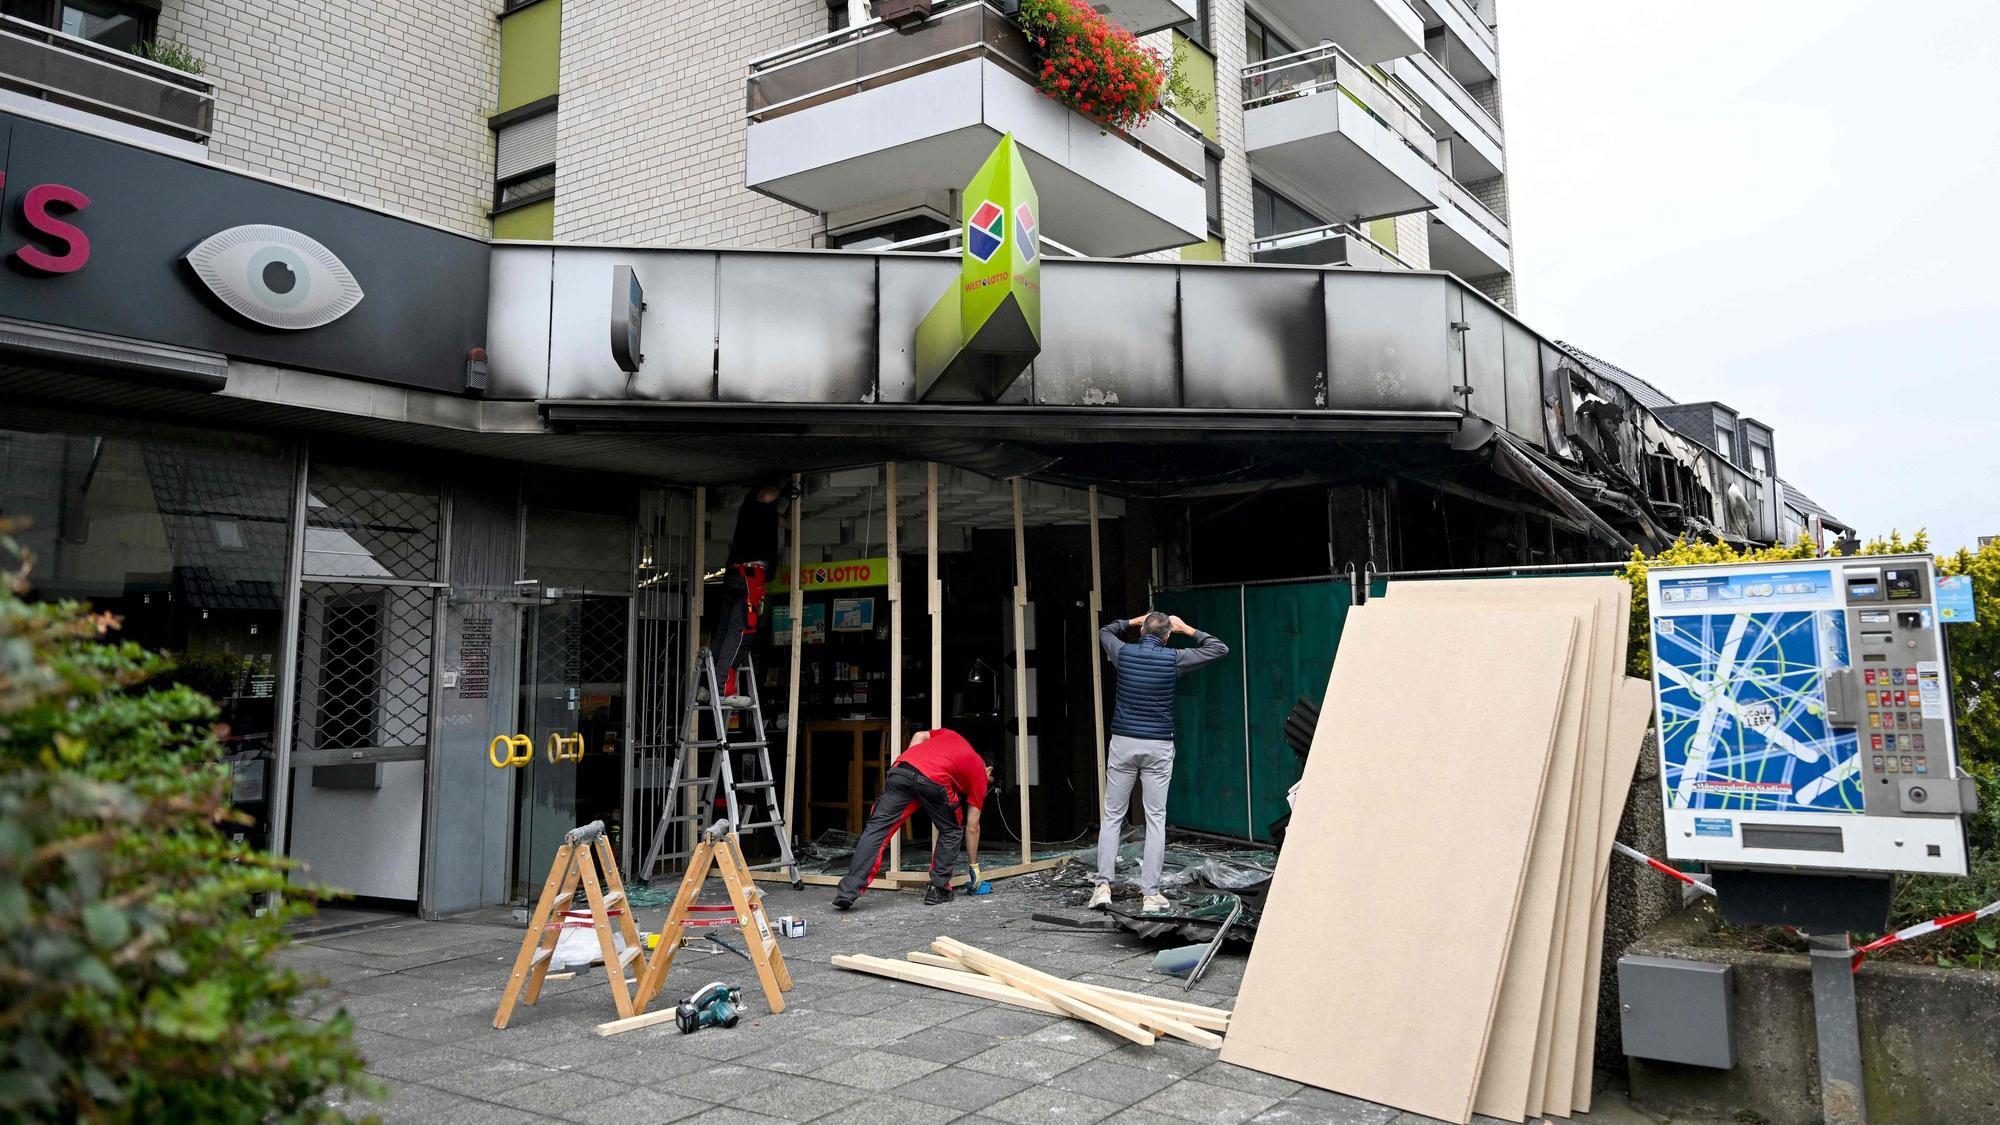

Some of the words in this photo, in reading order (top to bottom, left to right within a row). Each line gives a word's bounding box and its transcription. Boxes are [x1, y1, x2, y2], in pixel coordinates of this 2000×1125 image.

[0, 171, 92, 273] S
[965, 280, 981, 291] WEST
[987, 271, 1009, 286] LOTTO
[780, 568, 815, 586] WST
[827, 565, 871, 583] LOTTO
